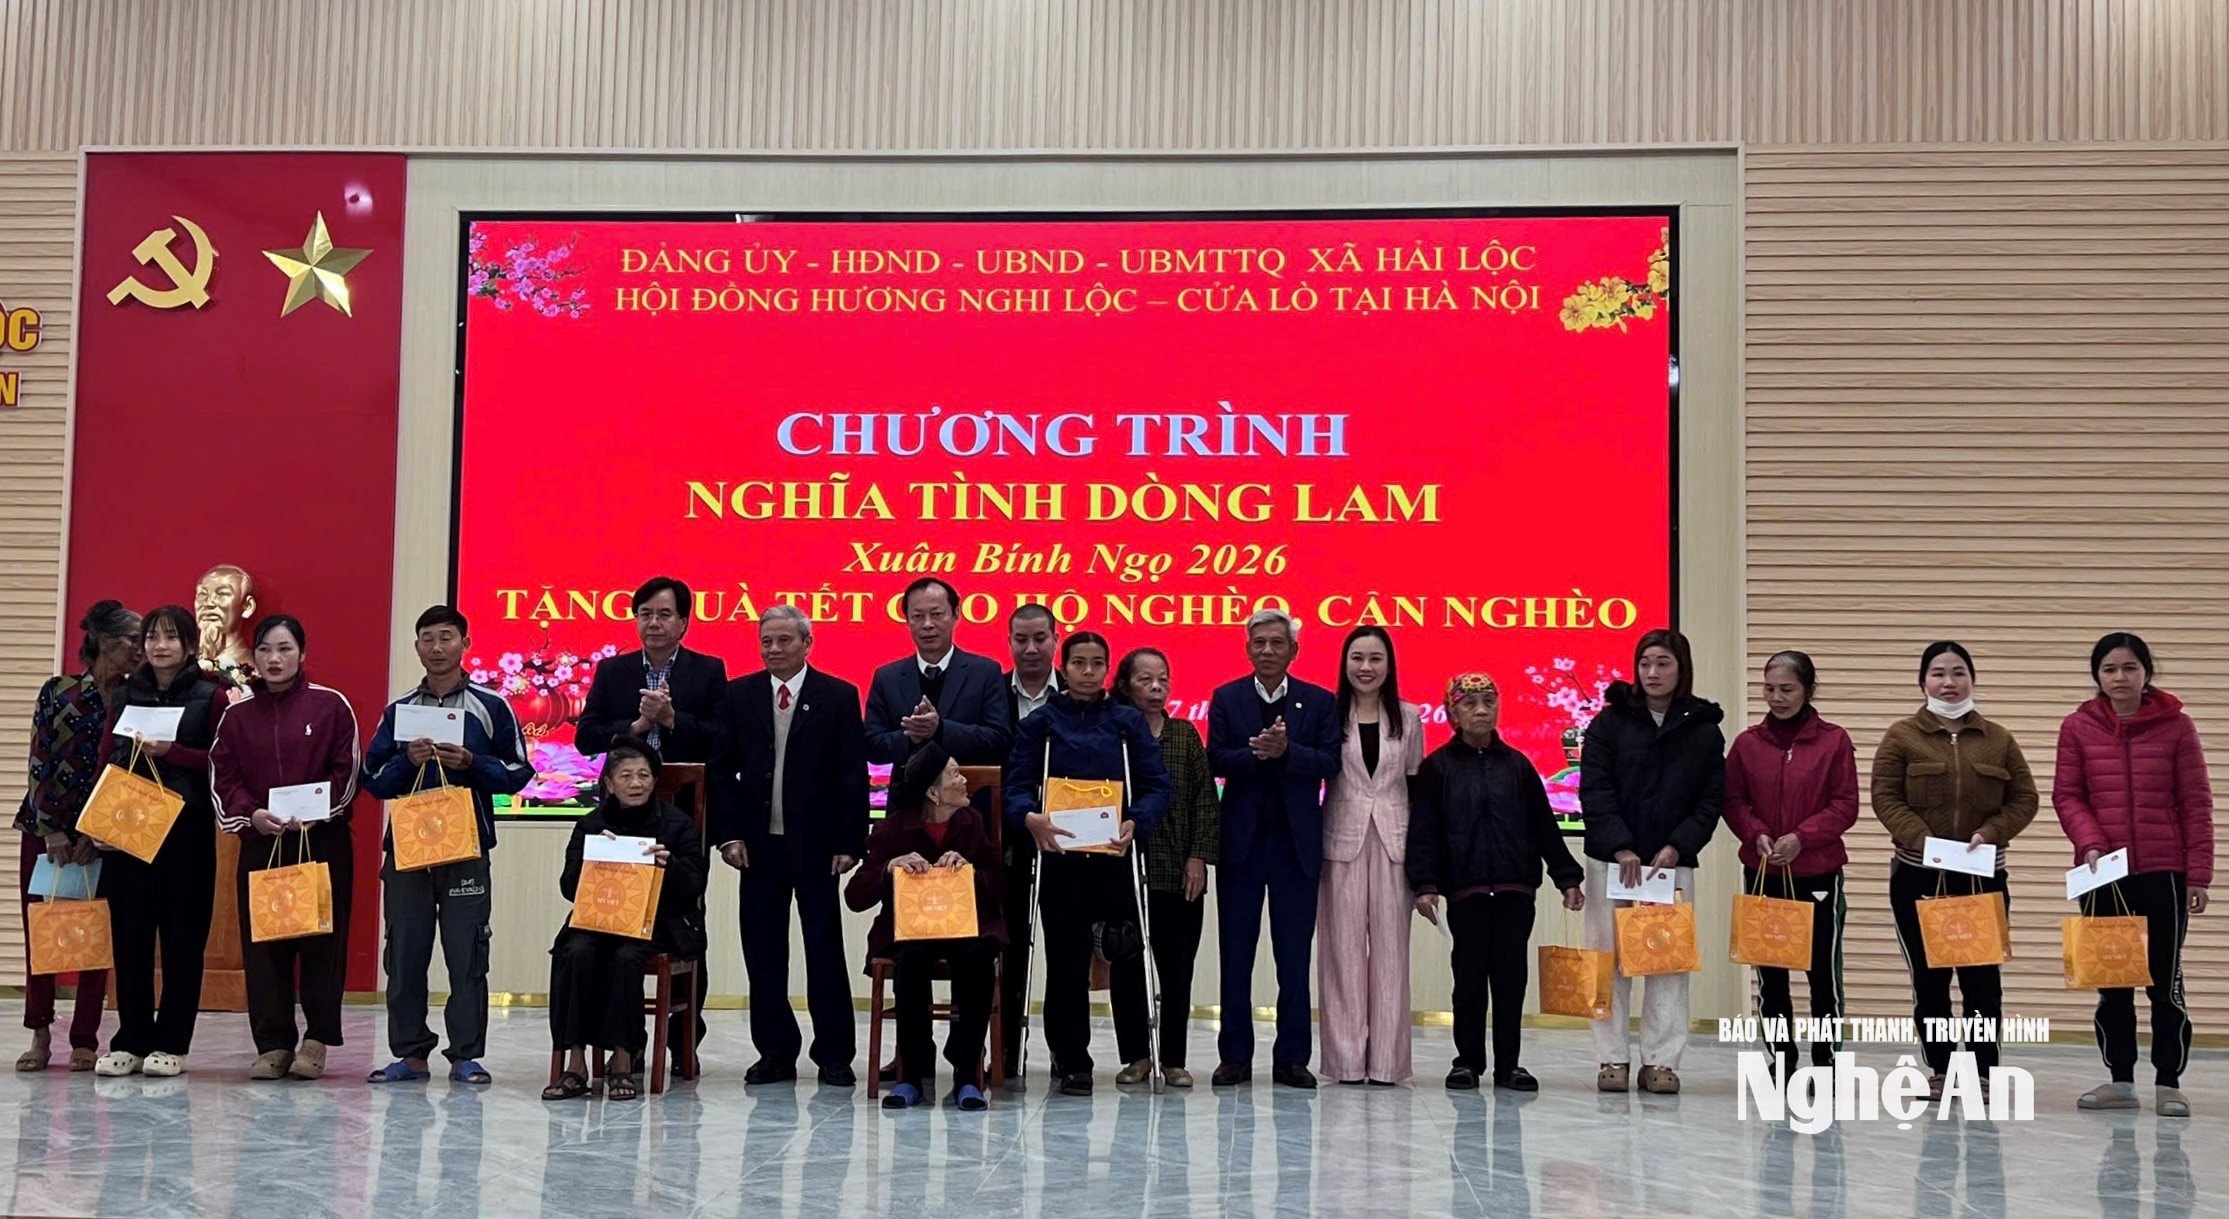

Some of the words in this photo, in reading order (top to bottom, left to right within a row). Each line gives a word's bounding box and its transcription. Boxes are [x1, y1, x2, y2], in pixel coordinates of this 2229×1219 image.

[622, 242, 731, 274] ĐẢNG
[744, 242, 797, 274] ỦY
[831, 249, 941, 274] HĐND
[976, 249, 1085, 274] UBND
[1120, 247, 1286, 278] UBMTTQ
[1307, 242, 1364, 273] XÃ
[1377, 239, 1443, 272] HẢI
[1458, 239, 1536, 275] LỘC
[616, 281, 679, 316] HỘI
[691, 281, 799, 312] ĐỒNG
[810, 285, 947, 312] HƯƠNG
[958, 288, 1051, 312] NGHI
[1064, 281, 1137, 316] LỘC
[1177, 281, 1259, 312] CỬA
[1269, 280, 1319, 312] LÒ
[1329, 286, 1392, 316] TẠI
[1405, 279, 1459, 311] HÀ
[1471, 279, 1540, 314] NỘI
[0, 300, 42, 353] C
[776, 405, 1098, 457] CHƯƠNG
[1116, 401, 1350, 457] TRÌNH
[684, 471, 896, 520] NGHĨA
[908, 470, 1067, 521] TÌNH
[1086, 471, 1274, 522] DÒNG
[1293, 483, 1442, 522] LAM
[842, 541, 957, 573] Xuân
[970, 542, 1072, 574] Bính
[1086, 543, 1173, 583] Ngọ
[1185, 543, 1288, 575] 2026
[496, 584, 636, 628] TẶNG
[692, 582, 760, 622] UÀ
[886, 591, 999, 625] CO
[1443, 587, 1639, 630] NGHÈO
